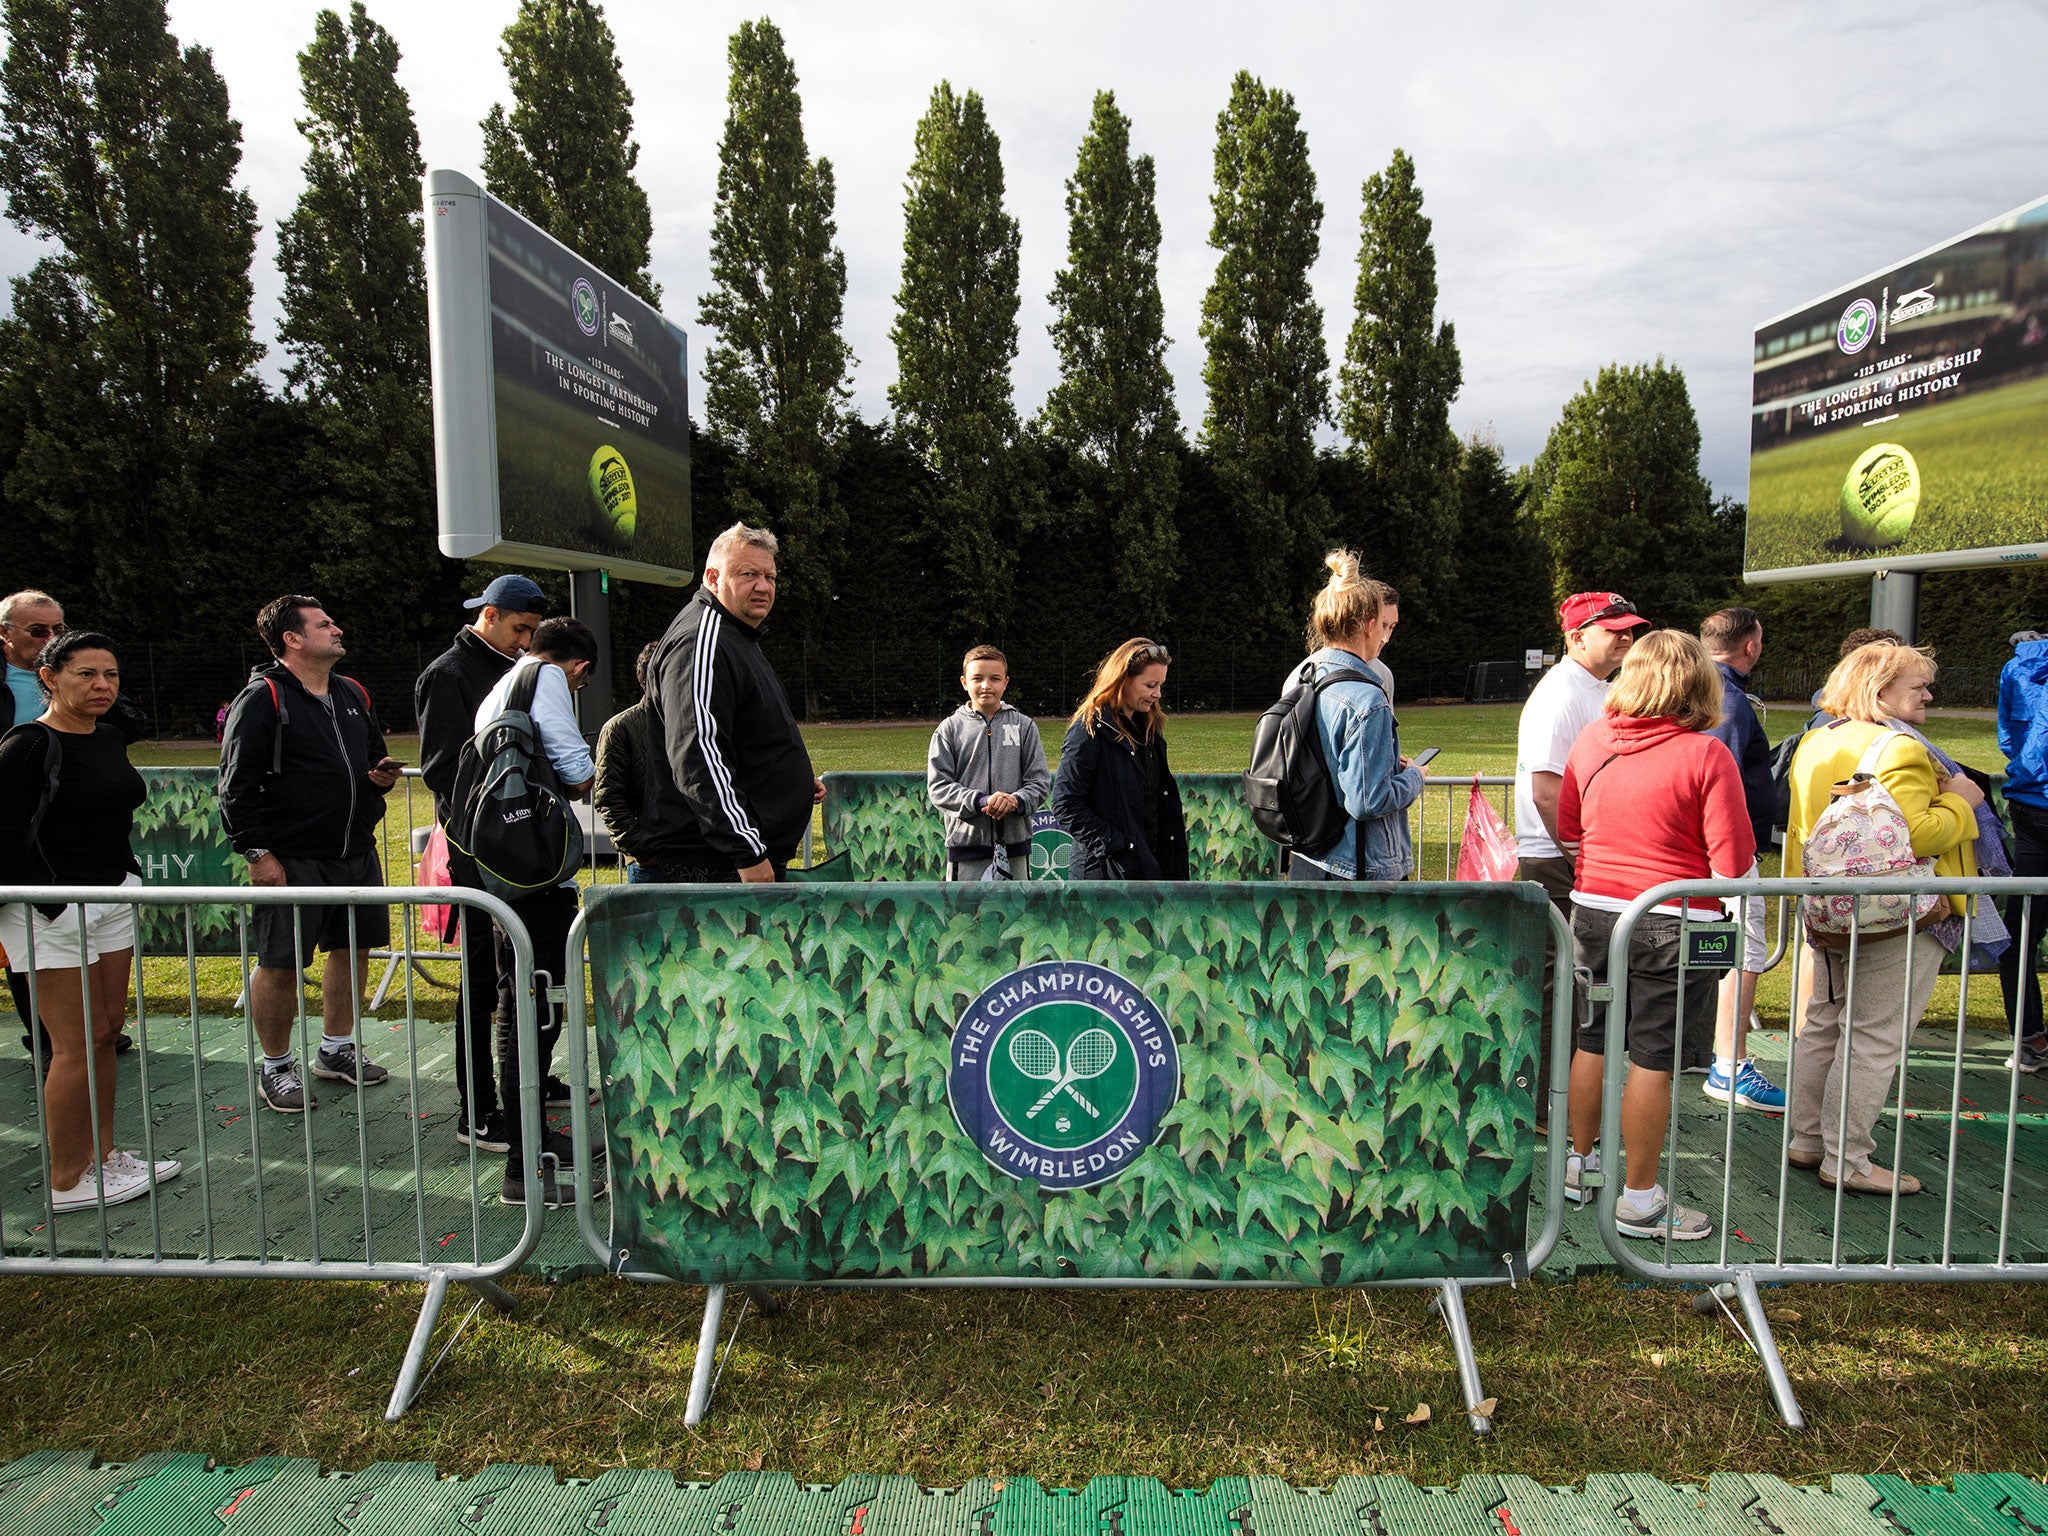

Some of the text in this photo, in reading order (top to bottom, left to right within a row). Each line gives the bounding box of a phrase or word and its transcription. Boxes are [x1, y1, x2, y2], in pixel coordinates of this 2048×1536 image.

[602, 362, 620, 380] YEARS
[1876, 354, 1906, 372] YEARS
[544, 350, 659, 416] THE LONGEST PARTNERSHIP
[1800, 348, 1982, 415] THE LONGEST PARTNERSHIP
[1813, 412, 1827, 427] IN
[1831, 393, 1893, 422] SPORTING
[1898, 372, 1962, 402] HISTORY
[559, 375, 570, 391] IN
[573, 382, 615, 412] SPORTING
[618, 403, 650, 428] HISTORY
[1862, 472, 1910, 508] WIMBLEDON
[1868, 495, 1887, 514] 1902
[1893, 480, 1910, 495] 2017
[1002, 724, 1020, 746] N
[502, 812, 515, 820] LA
[1698, 940, 1723, 950] Live
[959, 973, 1167, 1068] THE CHAMPIONSHIPS
[987, 1129, 1142, 1178] WIMBLEDON
